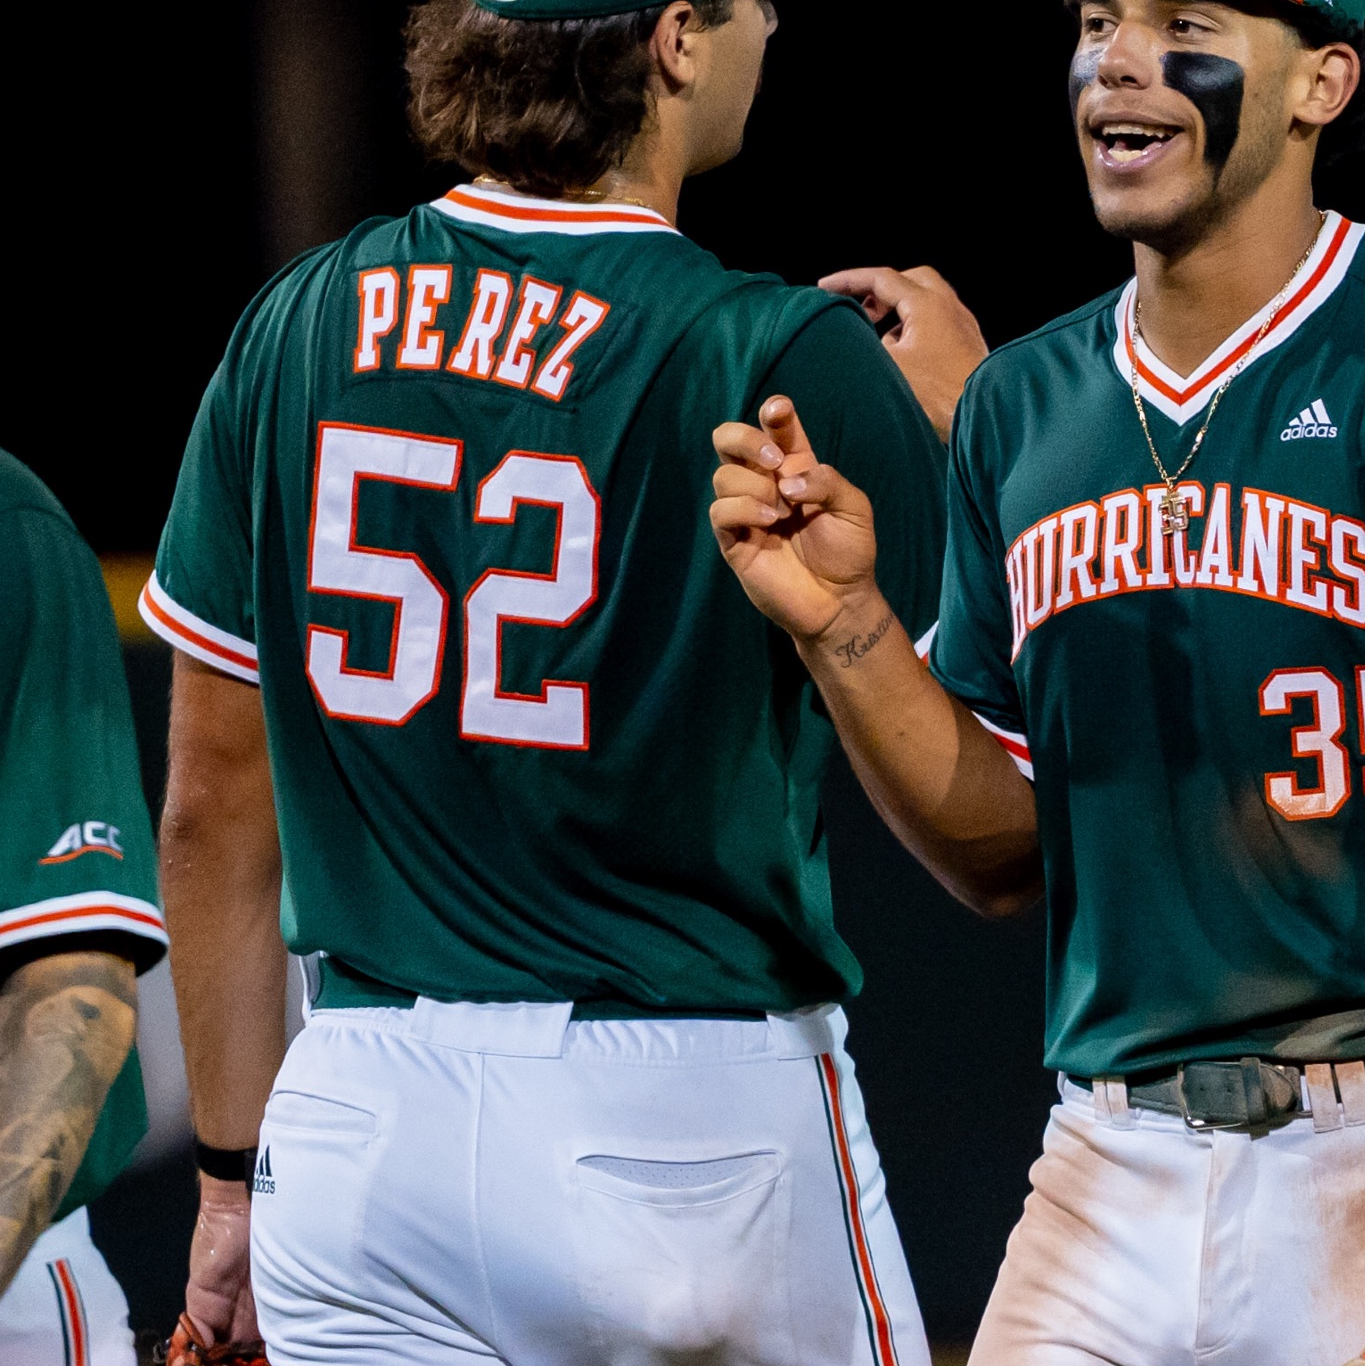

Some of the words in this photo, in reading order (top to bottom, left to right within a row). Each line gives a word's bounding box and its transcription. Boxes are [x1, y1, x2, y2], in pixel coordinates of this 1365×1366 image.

[353, 263, 611, 403] PEREZ
[1280, 422, 1338, 442] adidas
[305, 420, 602, 752] 52
[47, 821, 122, 857] ACC
